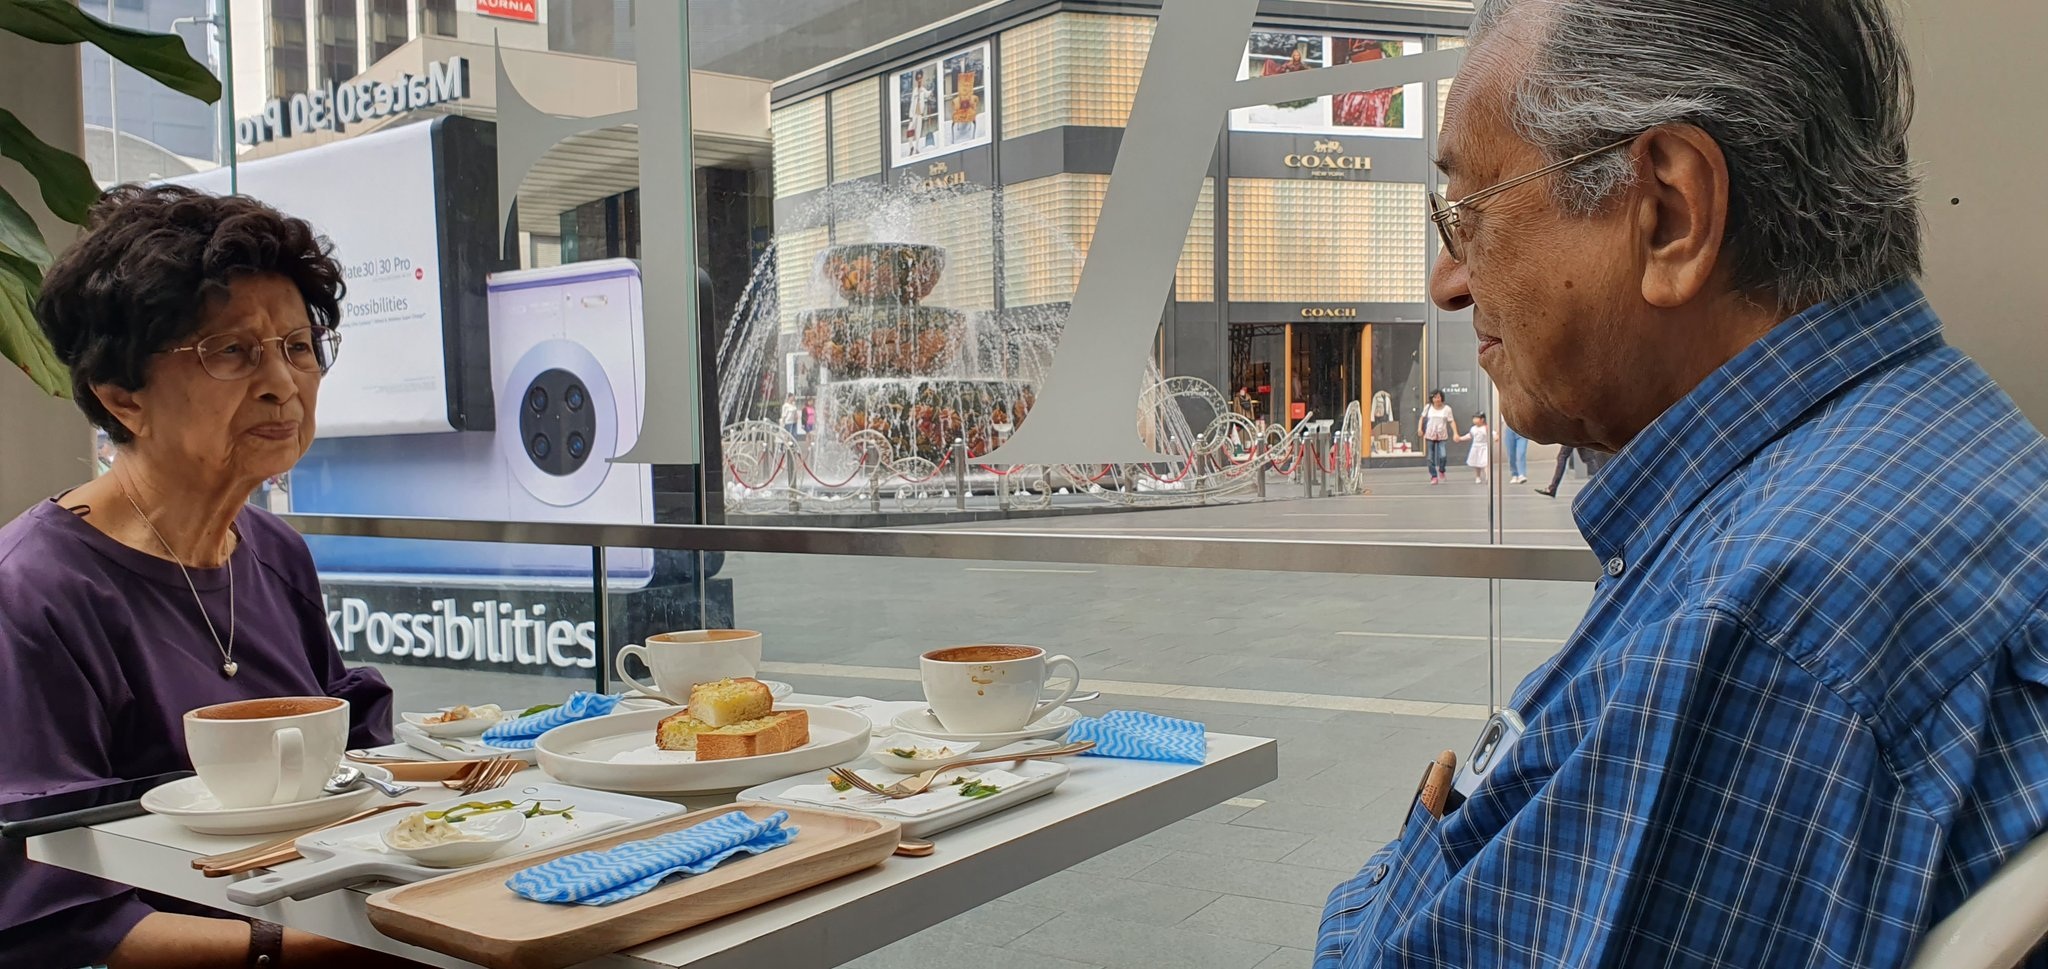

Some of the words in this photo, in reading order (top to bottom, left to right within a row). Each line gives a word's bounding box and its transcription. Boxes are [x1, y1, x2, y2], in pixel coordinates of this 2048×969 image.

[1284, 153, 1372, 169] COACH
[394, 257, 411, 272] Pro
[347, 297, 408, 317] Possibilities
[1301, 308, 1356, 317] COACH
